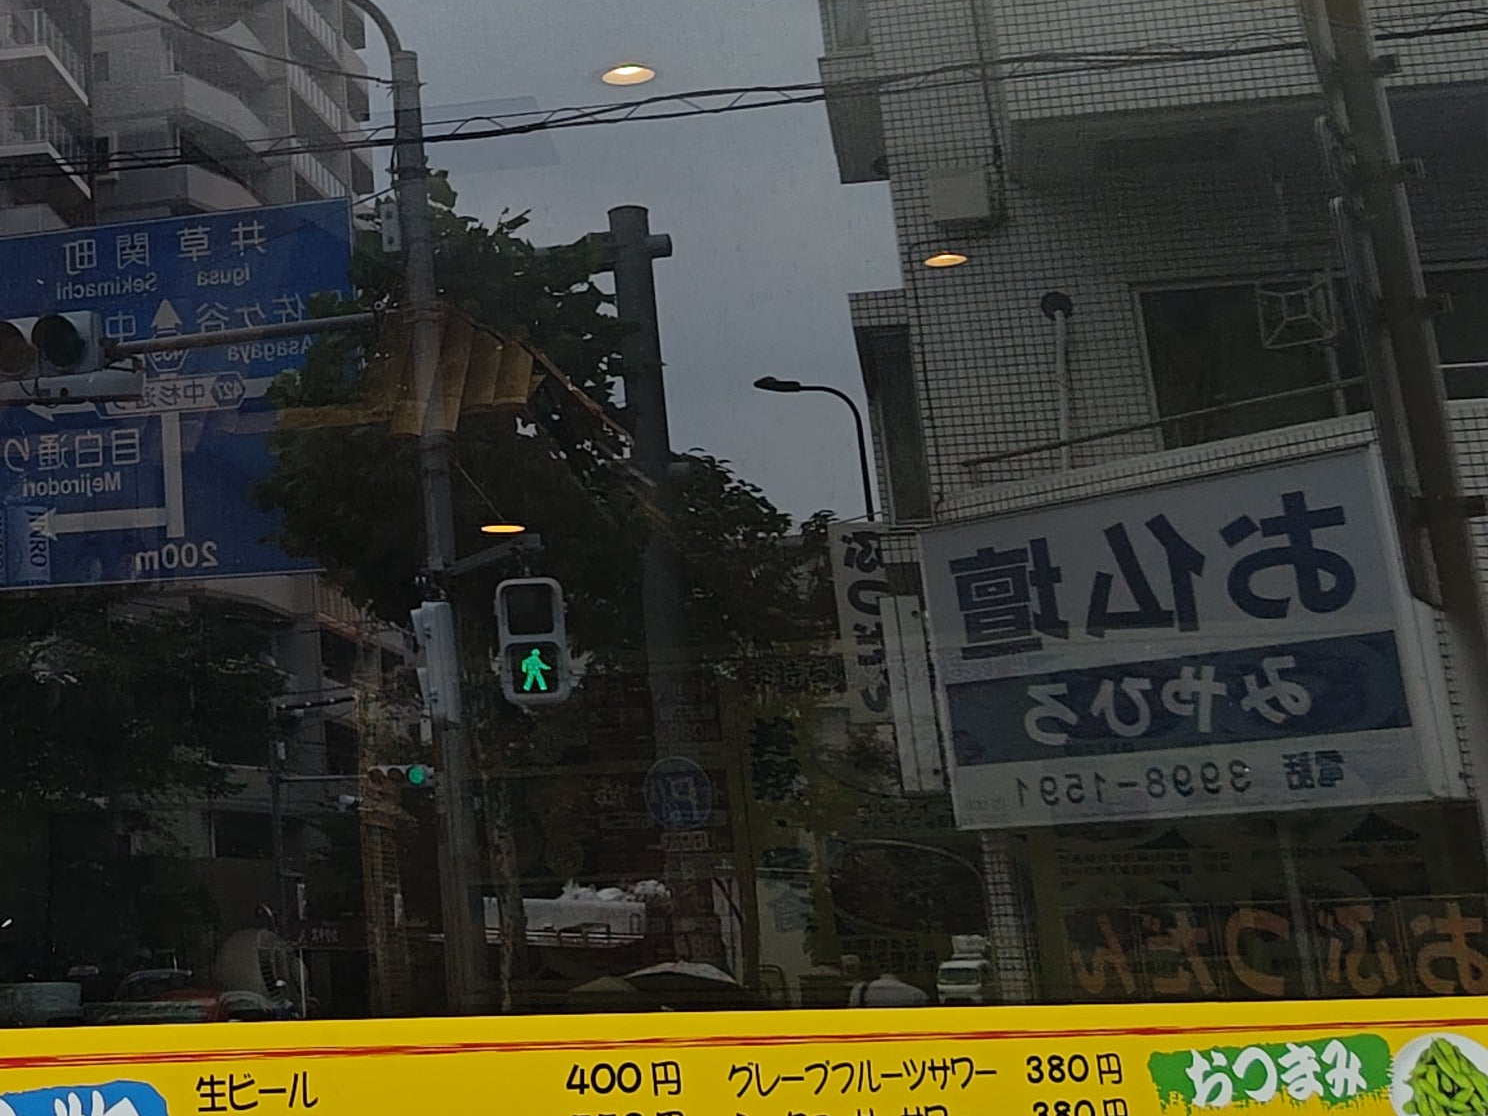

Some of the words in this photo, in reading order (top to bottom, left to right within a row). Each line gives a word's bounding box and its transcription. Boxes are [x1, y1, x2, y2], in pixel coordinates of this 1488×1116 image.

[194, 1070, 320, 1113] 生ビール
[565, 1061, 682, 1098] 400円
[727, 1056, 998, 1099] グレープフルーツサワー
[1025, 1053, 1124, 1086] 380円
[1184, 1039, 1368, 1109] おつまみ
